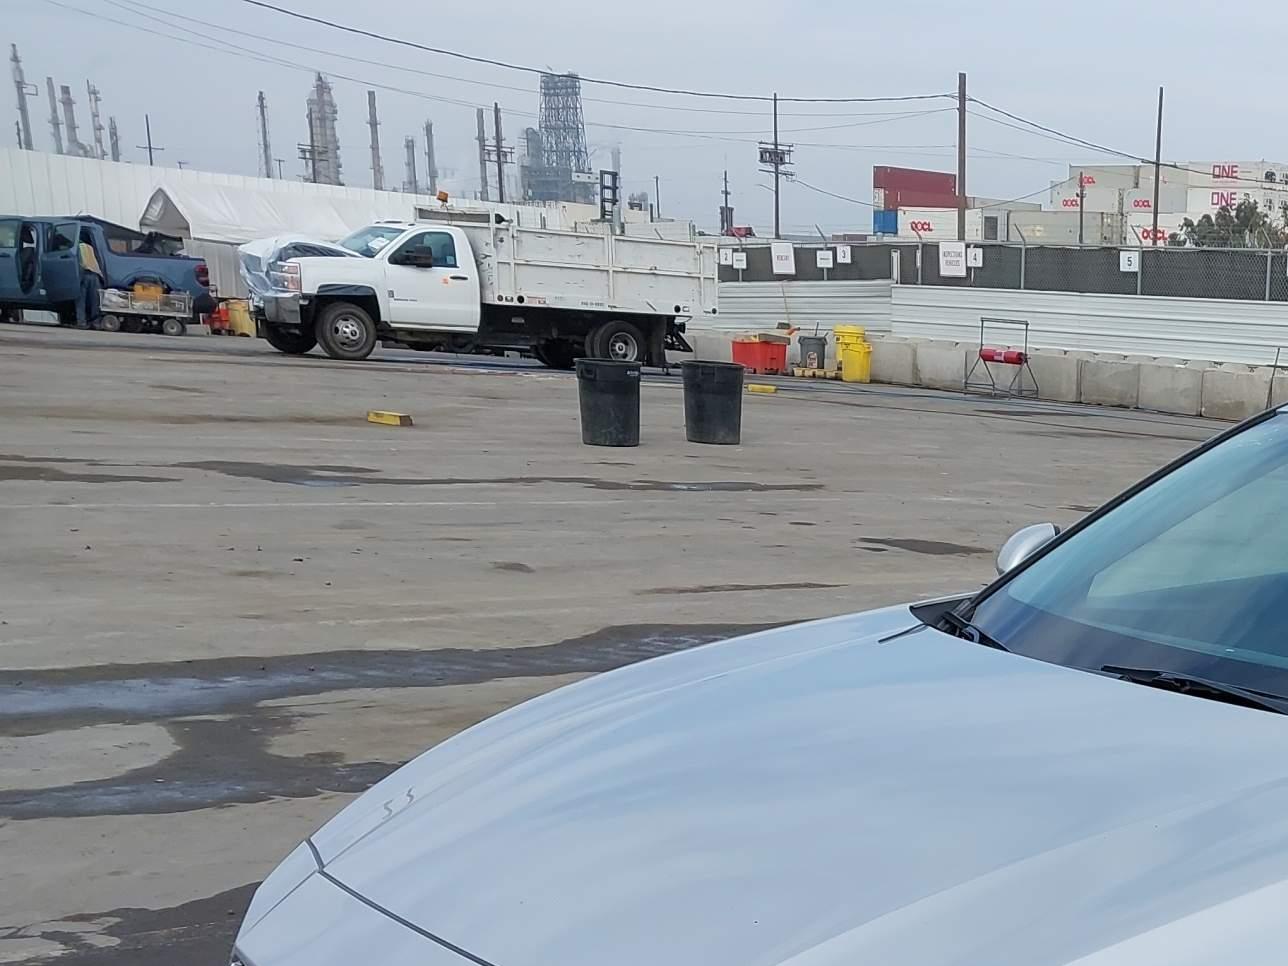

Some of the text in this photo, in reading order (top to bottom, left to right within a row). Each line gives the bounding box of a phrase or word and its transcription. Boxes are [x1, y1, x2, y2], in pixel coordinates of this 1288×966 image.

[1212, 164, 1239, 179] ONE
[1133, 199, 1152, 208] OOCL
[1211, 191, 1237, 206] ONE
[910, 220, 933, 232] OOCL
